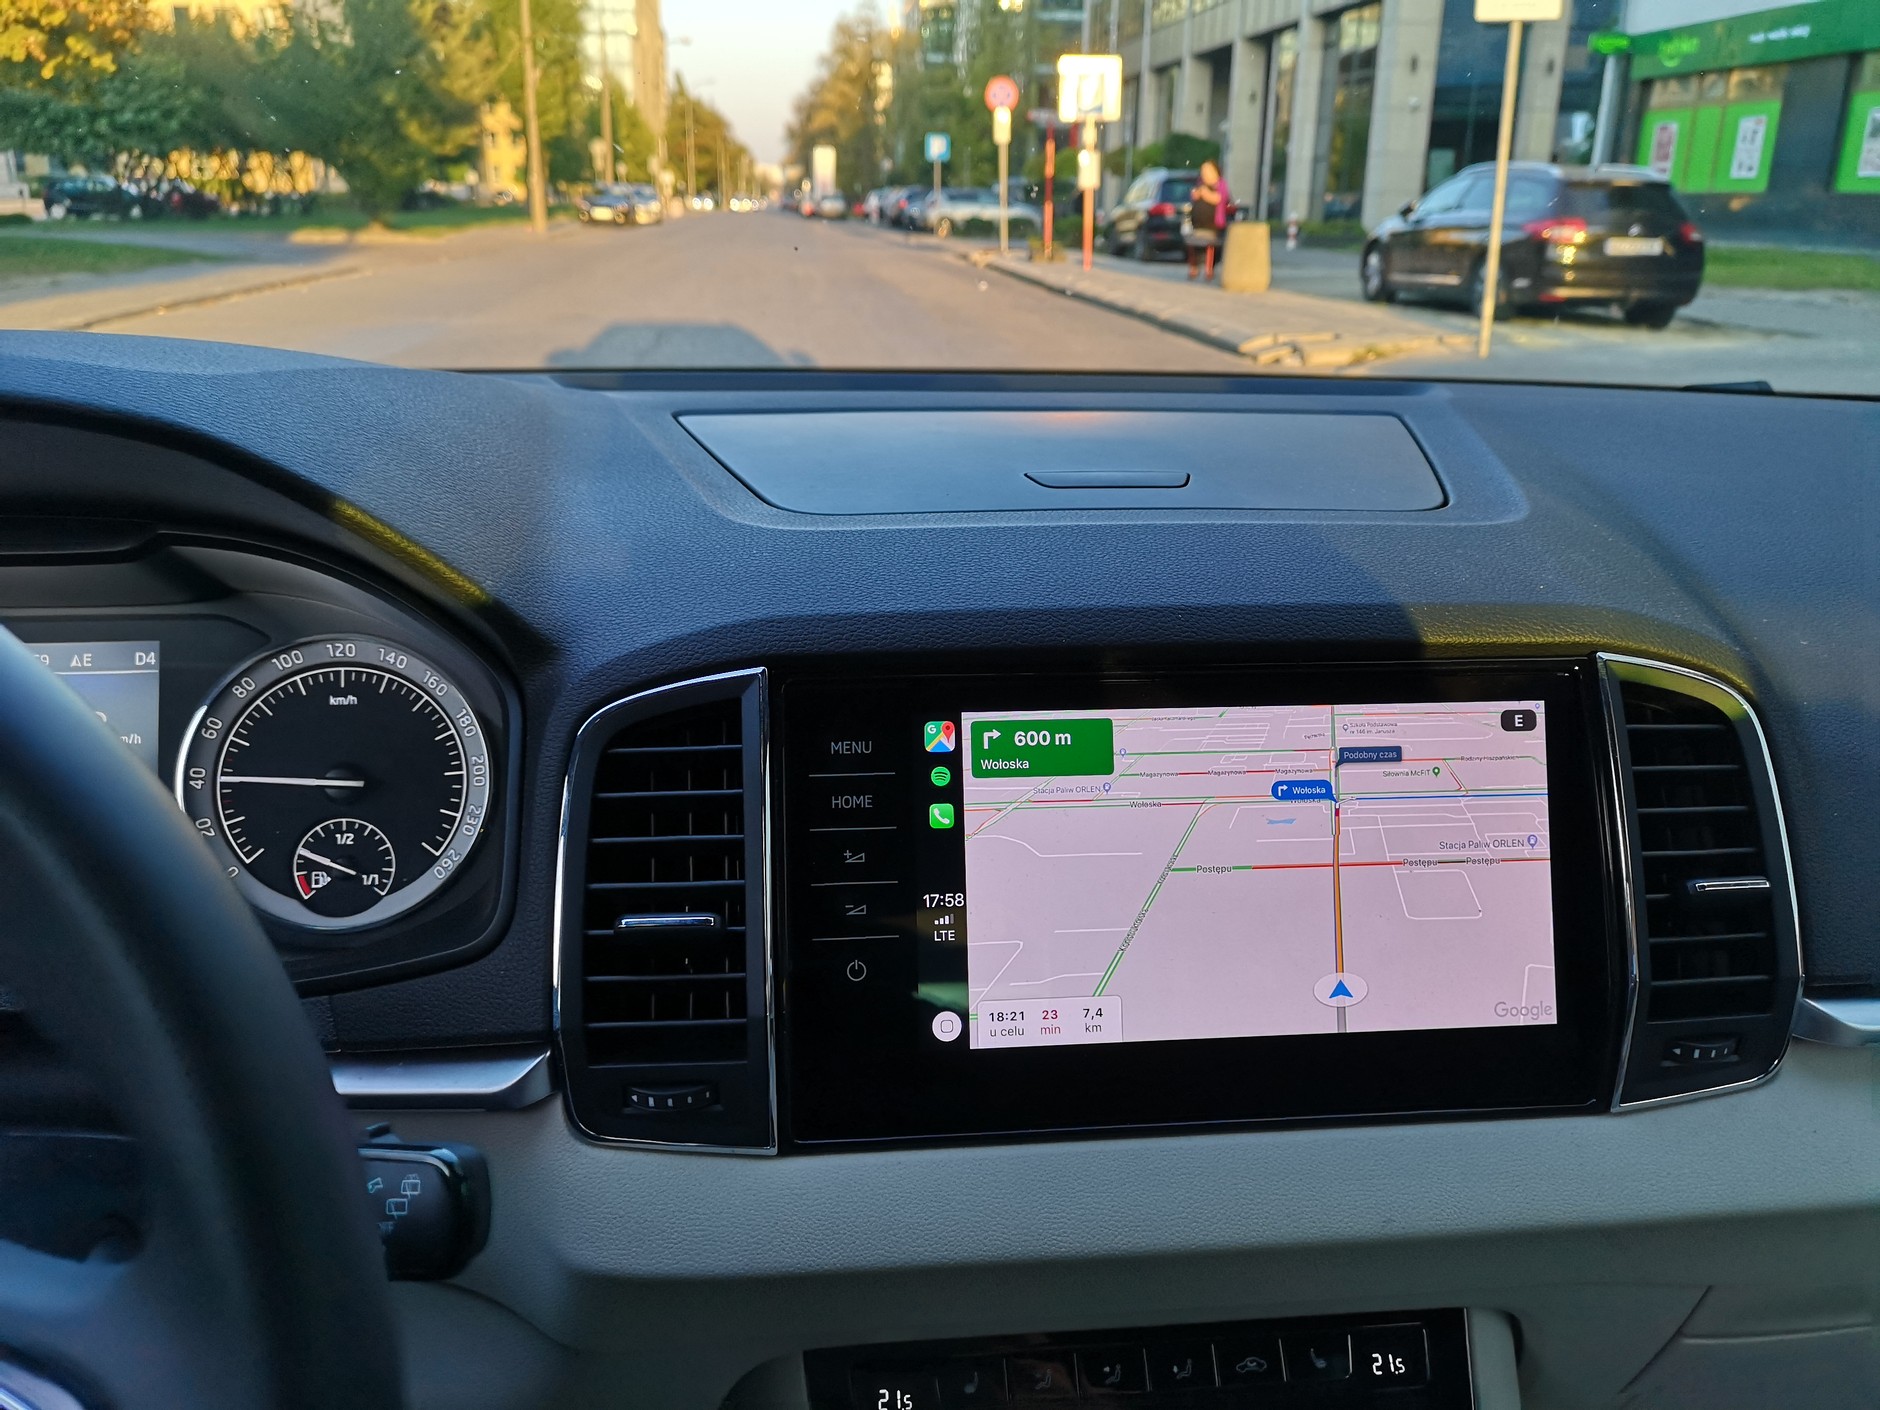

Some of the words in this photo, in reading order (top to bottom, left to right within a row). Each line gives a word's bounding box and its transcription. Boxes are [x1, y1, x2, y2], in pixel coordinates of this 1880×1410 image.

[327, 643, 356, 658] 120
[135, 651, 156, 666] D4
[271, 650, 304, 671] 100
[378, 648, 408, 669] 140
[232, 677, 256, 699] 80
[423, 670, 448, 697] 160
[329, 695, 358, 706] km/h
[455, 708, 477, 737] 180
[1514, 715, 1524, 727] E
[201, 717, 223, 740] 60
[1014, 730, 1051, 746] 600
[1055, 732, 1071, 745] m
[830, 740, 873, 755] MENU
[1343, 751, 1378, 760] Podobny
[1379, 751, 1398, 759] czas
[980, 758, 1030, 770] Wołoska
[472, 755, 486, 787] 200
[1410, 769, 1431, 777] McFIT
[189, 767, 206, 790] 40
[1033, 787, 1055, 795] Stacja
[1056, 786, 1074, 794] Paliw
[1075, 785, 1101, 793] ORLEN
[1292, 786, 1326, 794] Wołoska
[831, 795, 873, 809] HOME
[1129, 800, 1162, 808] Wołoska
[462, 805, 482, 836] 230
[195, 817, 216, 837] 20
[335, 833, 355, 845] 1/2
[1439, 841, 1466, 851] Stacja
[1468, 840, 1490, 849] Paliw
[1492, 839, 1525, 848] ORLEN
[433, 848, 461, 879] 260
[1403, 857, 1438, 868] Postępu
[1466, 856, 1500, 867] Postępu
[1196, 864, 1232, 874] Postępu
[361, 873, 379, 886] 1/1
[923, 893, 965, 908] 17:58
[934, 930, 956, 941] LTE
[988, 1011, 1025, 1022] 18:21
[1041, 1009, 1058, 1020] 23
[1082, 1008, 1104, 1020] 7,4
[1494, 1001, 1553, 1020] Google
[989, 1029, 997, 1037] u
[1000, 1026, 1025, 1037] celu
[1040, 1024, 1061, 1035] min
[1085, 1023, 1102, 1033] km
